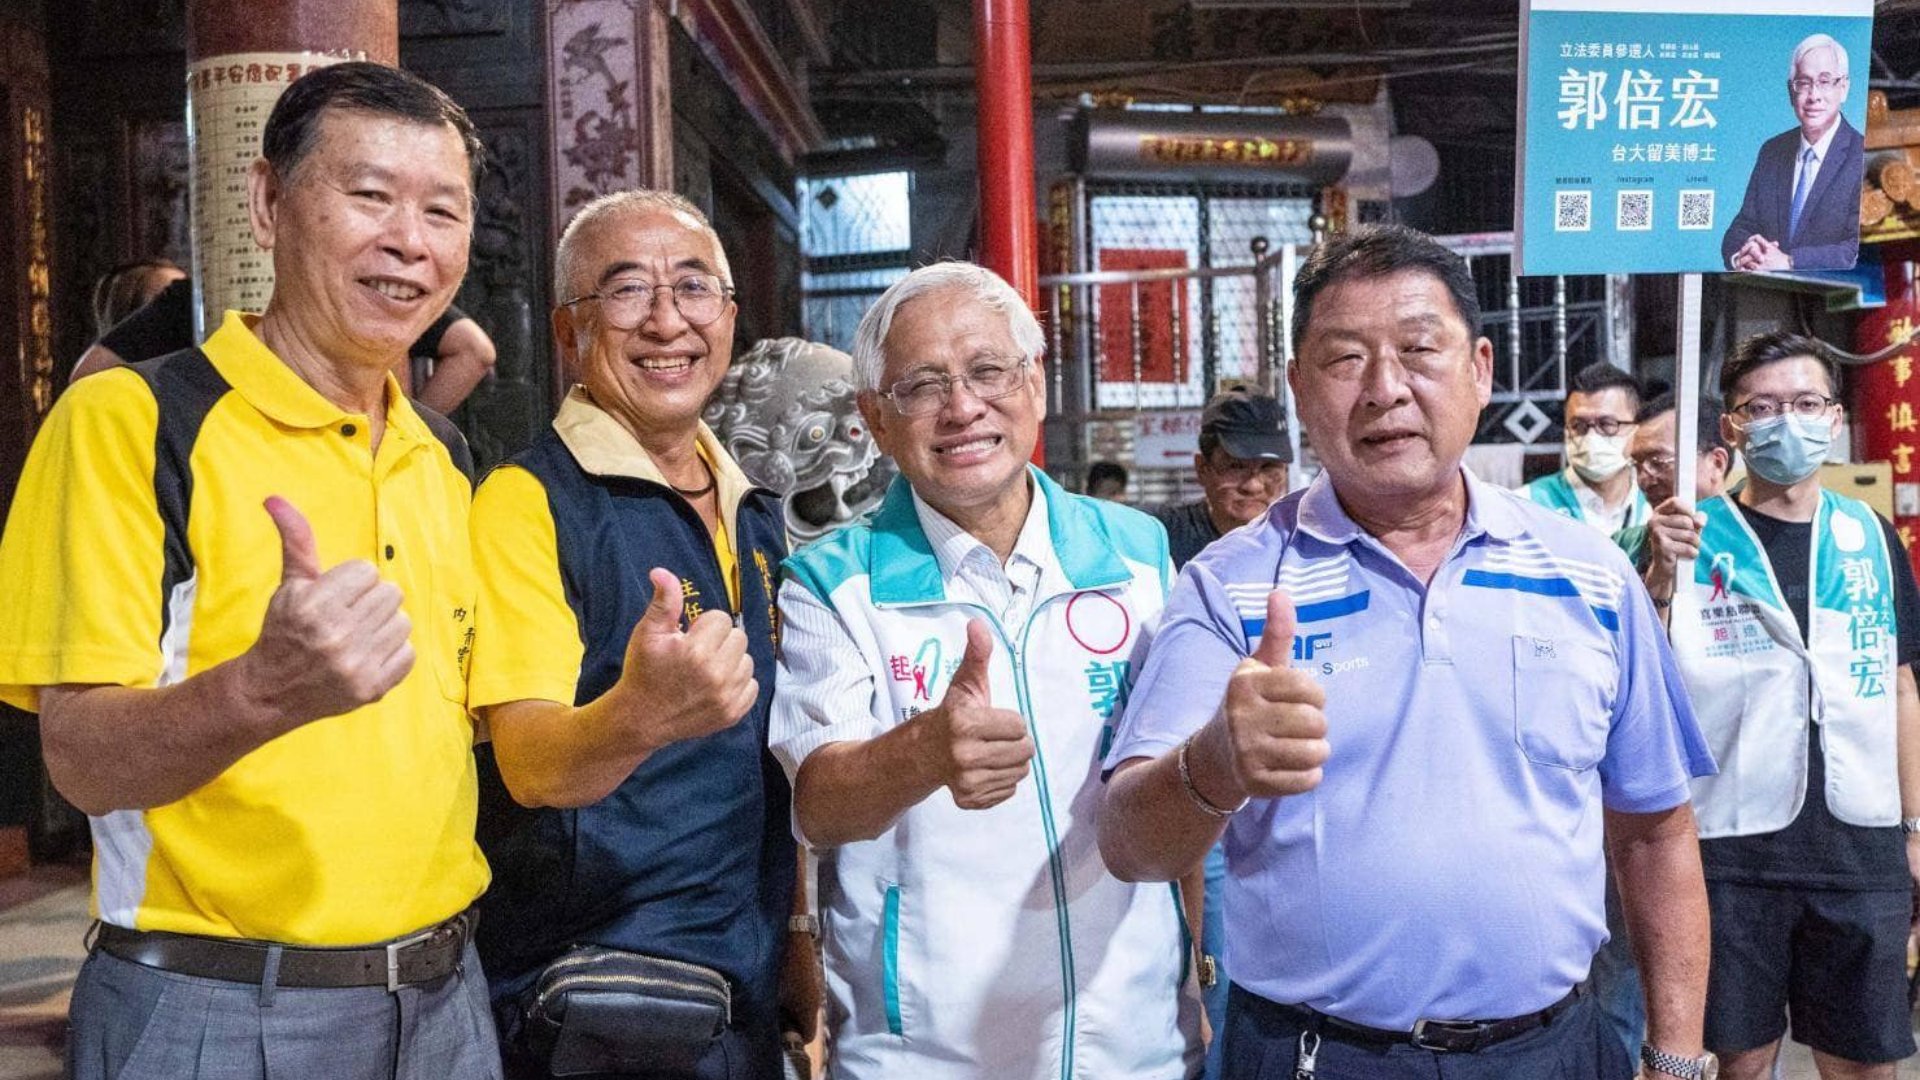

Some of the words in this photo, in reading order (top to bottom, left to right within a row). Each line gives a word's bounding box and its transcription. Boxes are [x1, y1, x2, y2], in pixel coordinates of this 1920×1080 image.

[1557, 67, 1719, 130] 郭倍宏
[1612, 143, 1717, 162] 台大留美博士
[1840, 558, 1886, 698] 郭倍宏
[1322, 657, 1369, 675] Sports
